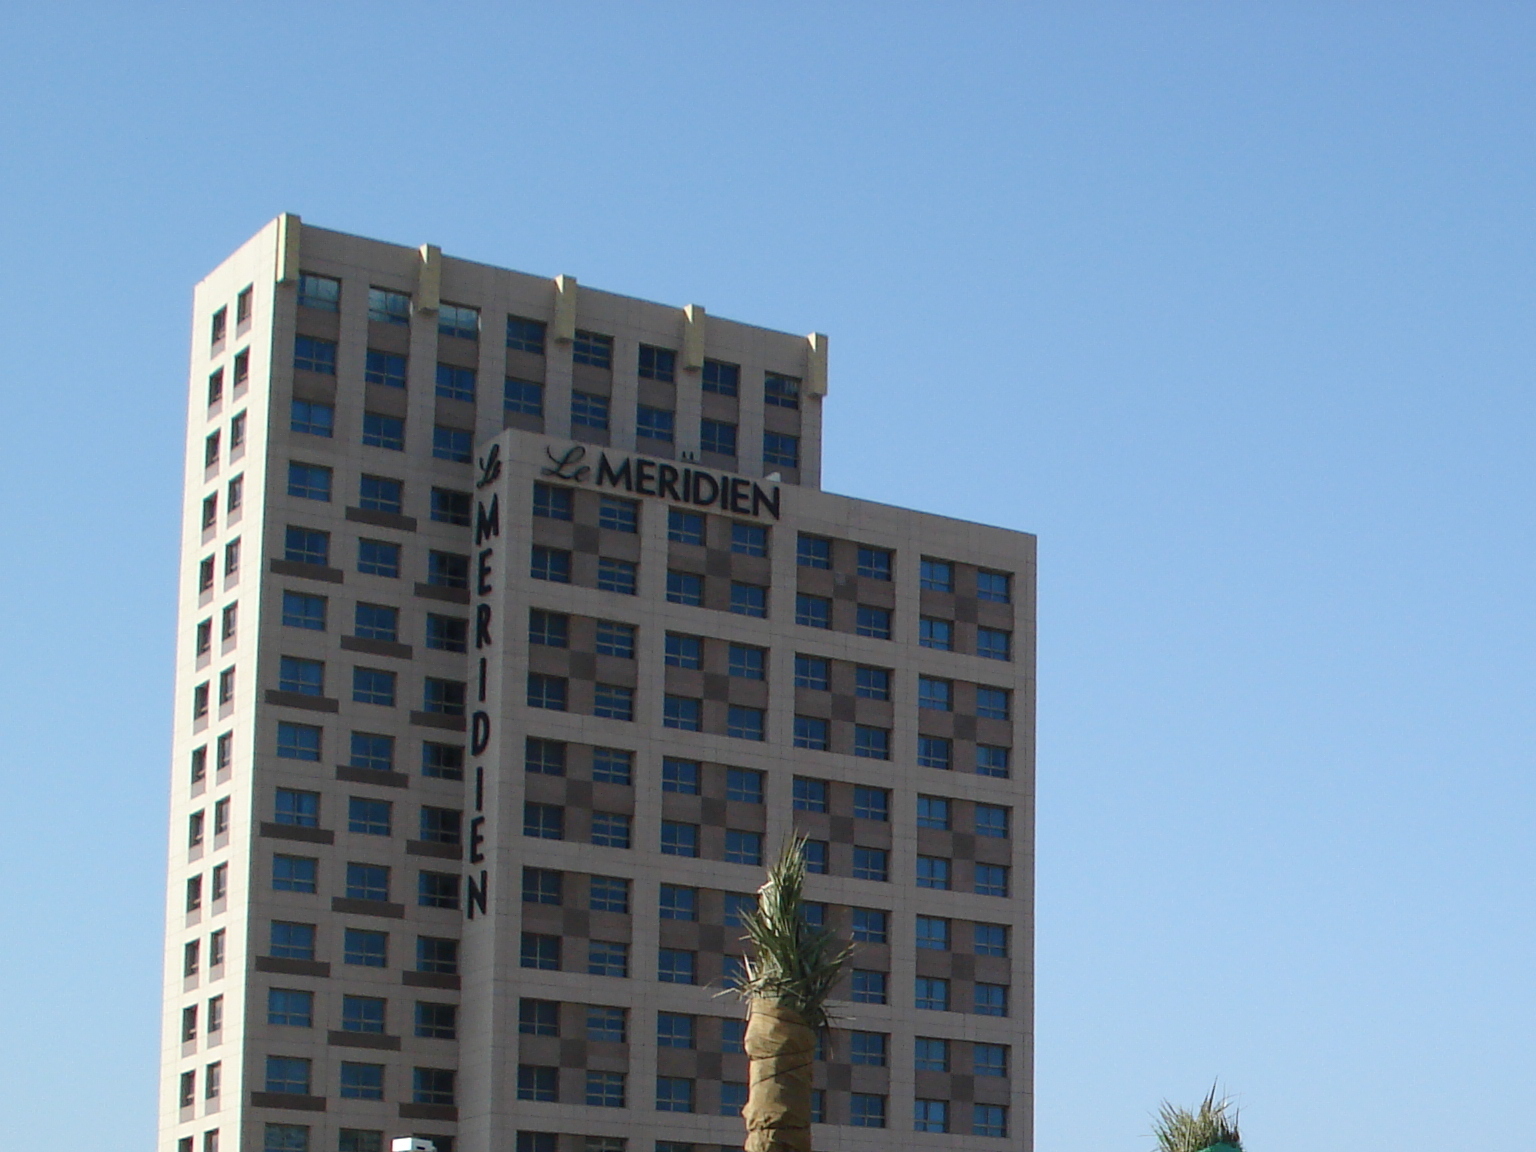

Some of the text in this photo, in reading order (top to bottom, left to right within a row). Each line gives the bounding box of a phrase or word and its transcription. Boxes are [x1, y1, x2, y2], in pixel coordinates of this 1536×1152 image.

[541, 445, 780, 520] Le MERIDIEN
[467, 443, 501, 921] Le MERIDIEN
